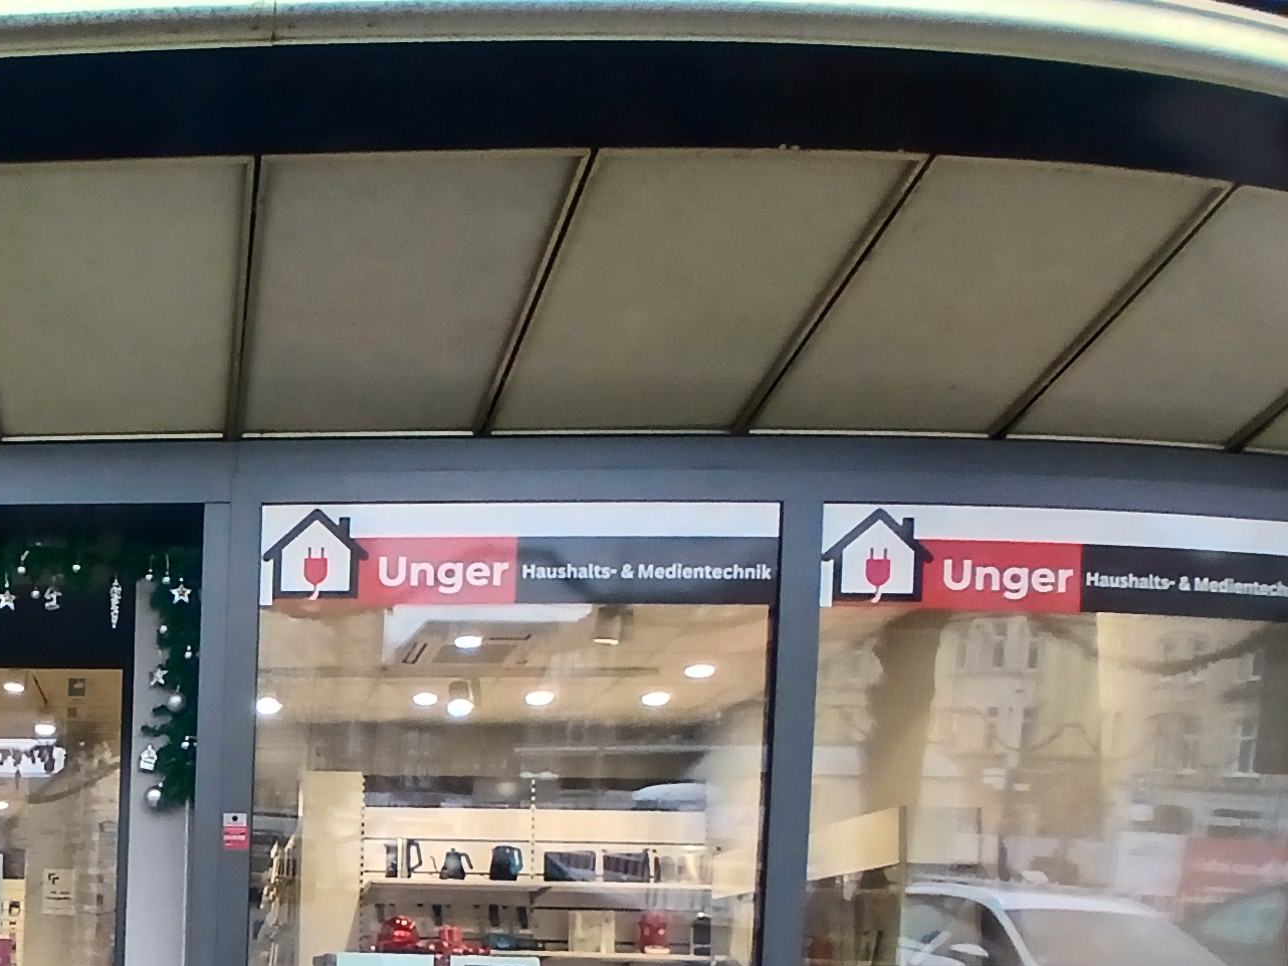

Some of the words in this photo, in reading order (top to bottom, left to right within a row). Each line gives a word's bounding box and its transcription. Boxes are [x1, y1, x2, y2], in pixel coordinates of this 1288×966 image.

[378, 556, 510, 595] Unger
[521, 563, 618, 580] Haushalts-
[620, 564, 635, 580] &
[637, 562, 772, 580] Medientechnik
[942, 558, 1074, 600] Unger
[1085, 571, 1176, 591] Haushalts-
[1178, 575, 1192, 592] &
